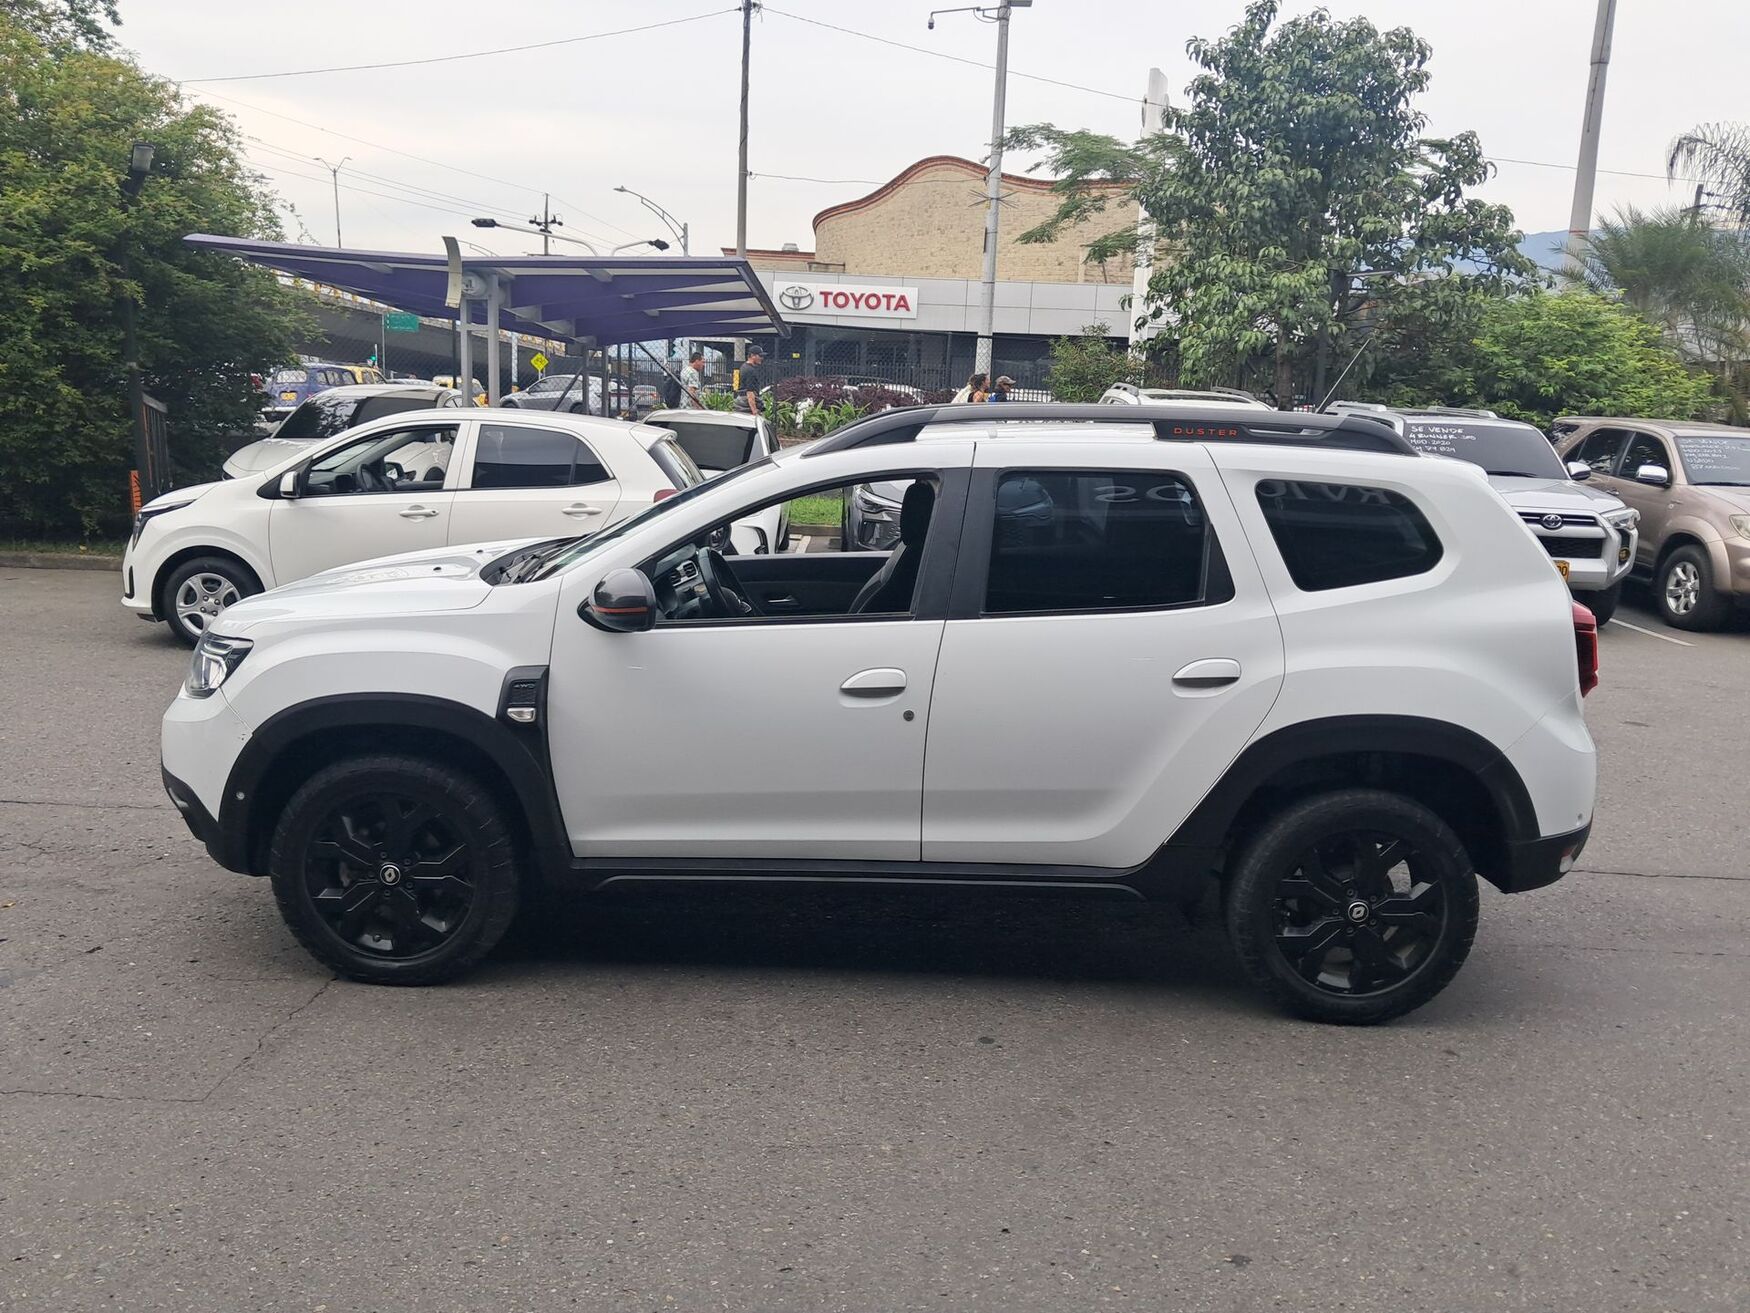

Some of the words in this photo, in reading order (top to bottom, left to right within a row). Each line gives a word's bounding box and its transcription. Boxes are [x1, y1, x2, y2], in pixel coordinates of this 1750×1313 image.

[819, 291, 911, 312] TOYOTA
[1173, 427, 1238, 436] DUSTER
[1428, 426, 1464, 434] VENDE
